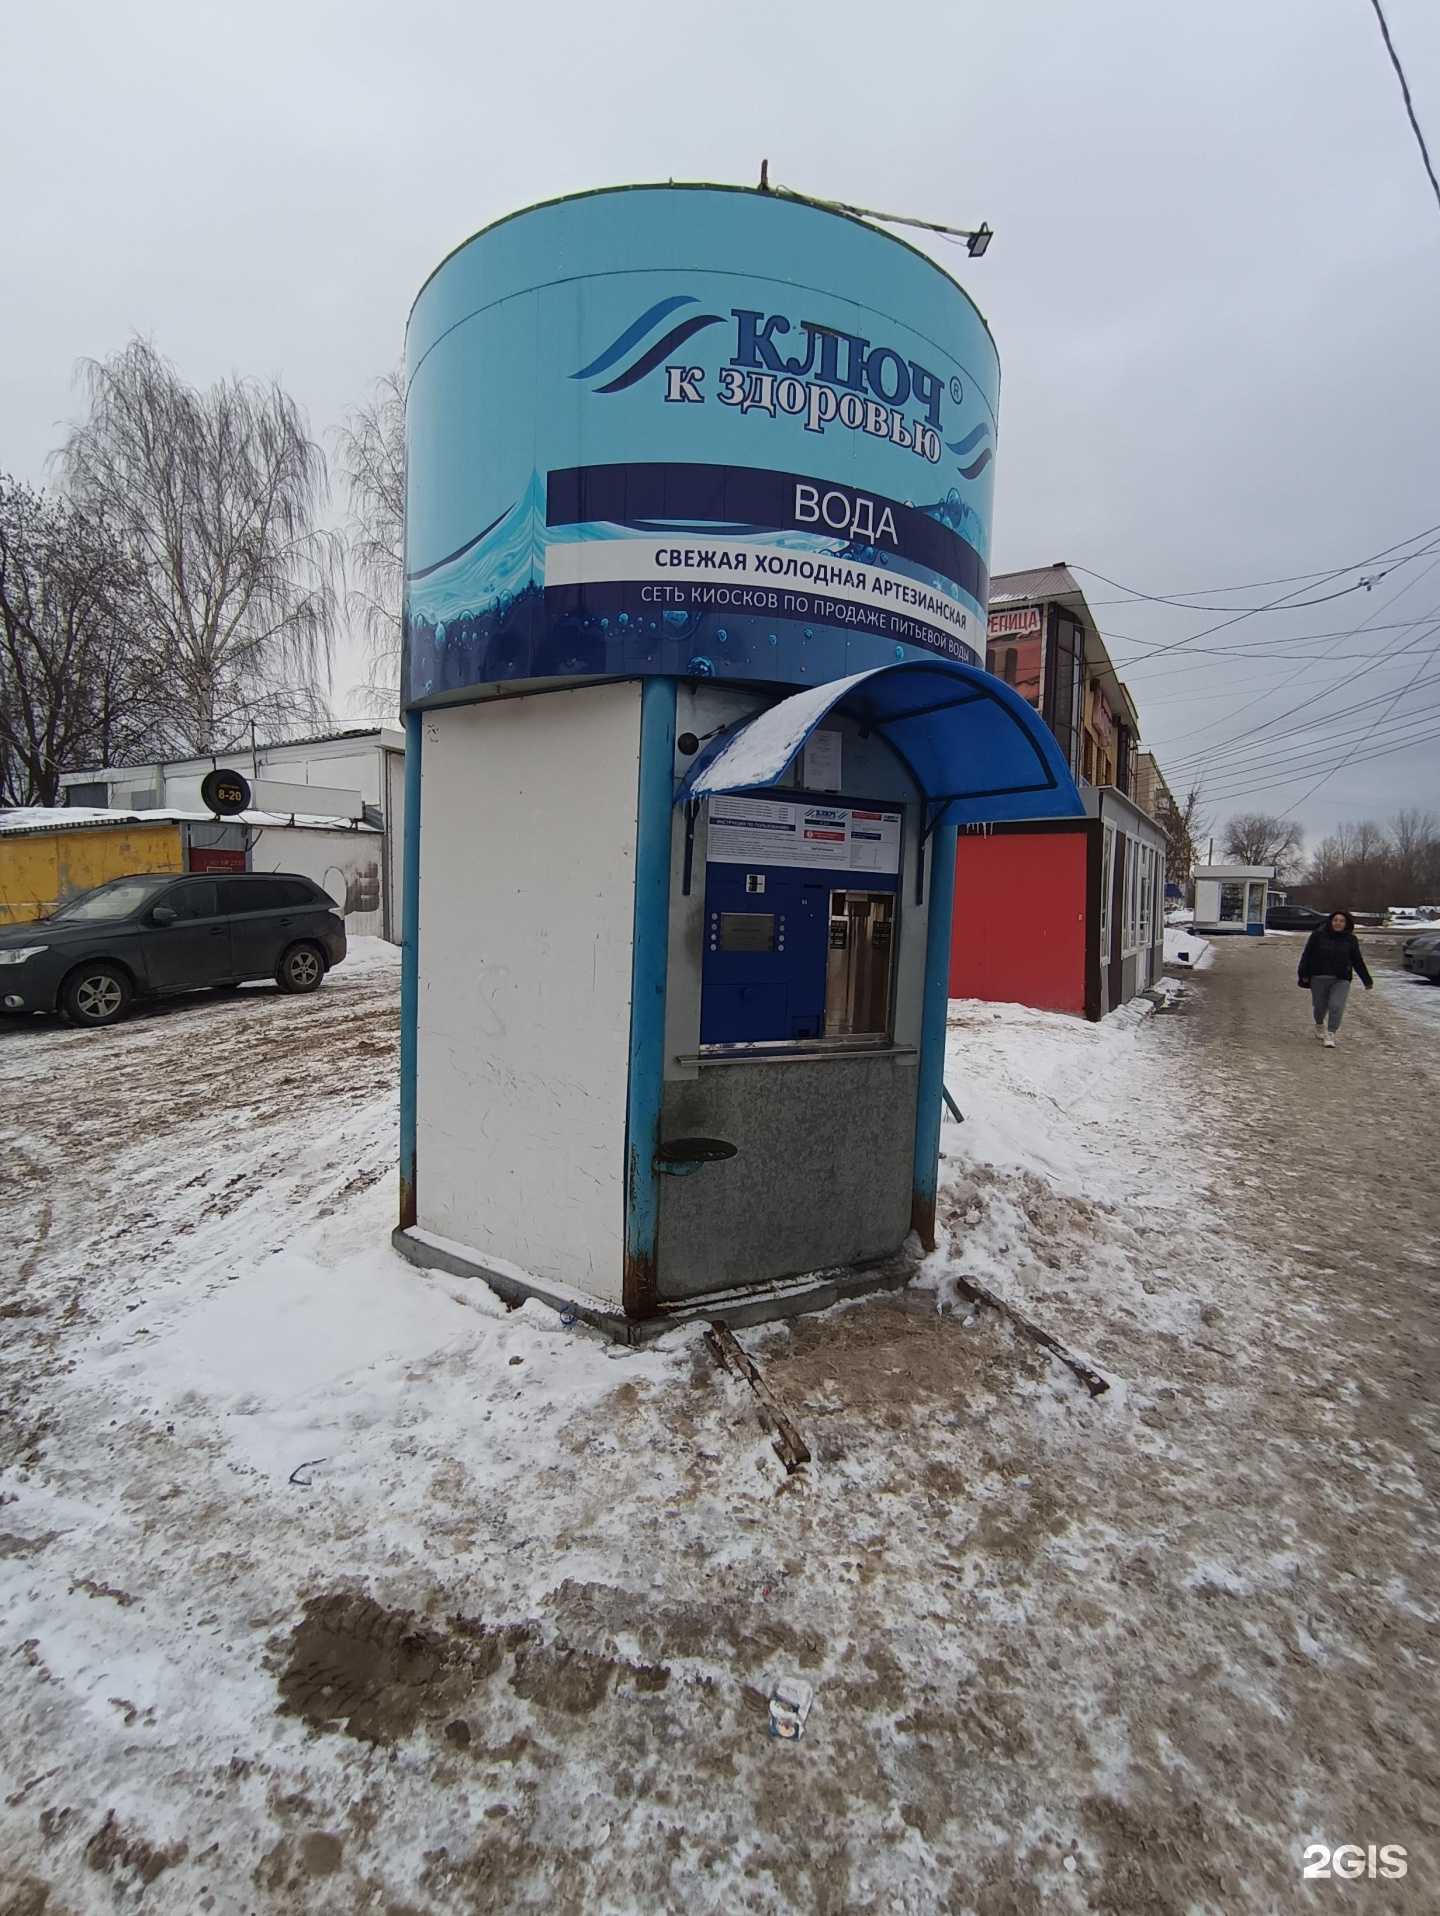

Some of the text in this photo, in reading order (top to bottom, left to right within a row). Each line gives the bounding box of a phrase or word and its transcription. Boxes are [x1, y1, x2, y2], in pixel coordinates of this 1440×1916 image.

[729, 309, 945, 432] КЛЮЧ
[795, 484, 898, 545] ВОДА
[641, 586, 970, 662] СЕТЬ КИОСКОВ ПО ПРОДАЖЕ ПИТЬЕВОЙ ВОДЫ
[655, 548, 967, 631] СВЕЖАЯ ХОЛОДНАЯ АРТЕЗИАНСКАЯ
[218, 788, 242, 801] 8-20
